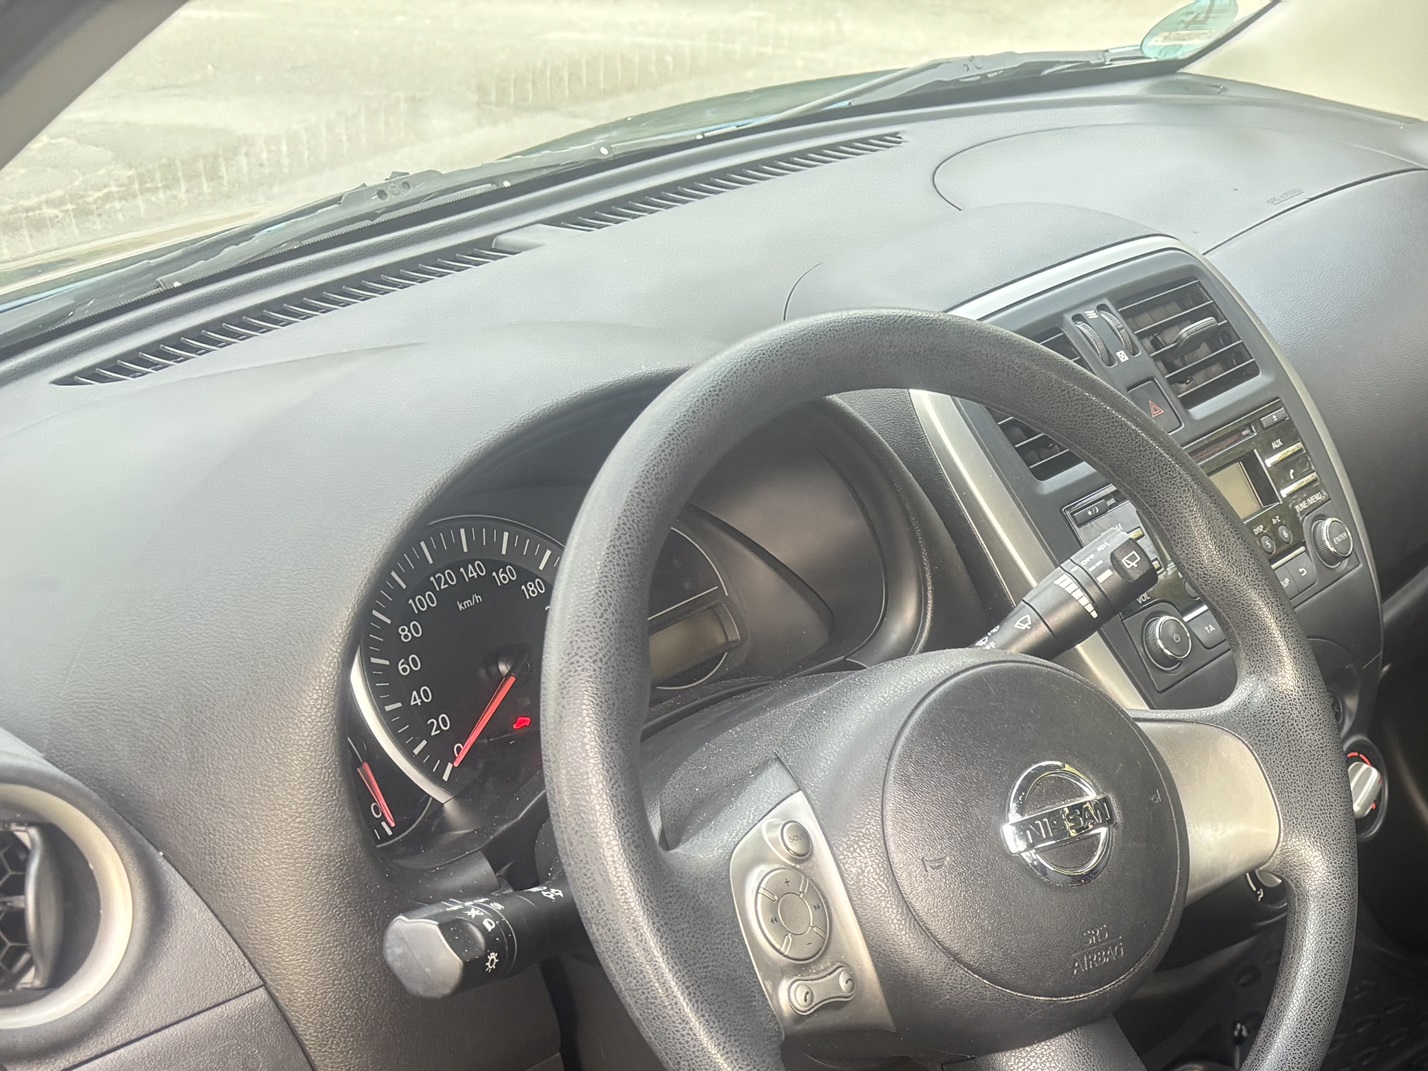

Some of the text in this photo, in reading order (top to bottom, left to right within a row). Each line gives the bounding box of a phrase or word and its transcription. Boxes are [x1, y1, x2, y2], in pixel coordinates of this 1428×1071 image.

[1271, 438, 1284, 450] AUX
[1264, 540, 1272, 549] 5
[429, 569, 457, 592] 120
[459, 560, 487, 583] 140
[492, 564, 518, 587] 160
[521, 578, 546, 600] 180
[1136, 592, 1151, 604] VOL
[408, 590, 438, 615] 100
[456, 593, 483, 611] km/h
[397, 620, 423, 643] 80
[1204, 624, 1216, 635] TA
[397, 654, 421, 676] 60
[409, 685, 433, 707] 40
[427, 713, 451, 736] 20
[1025, 801, 1112, 844] NISSAN
[1073, 943, 1124, 974] AIRBAG
